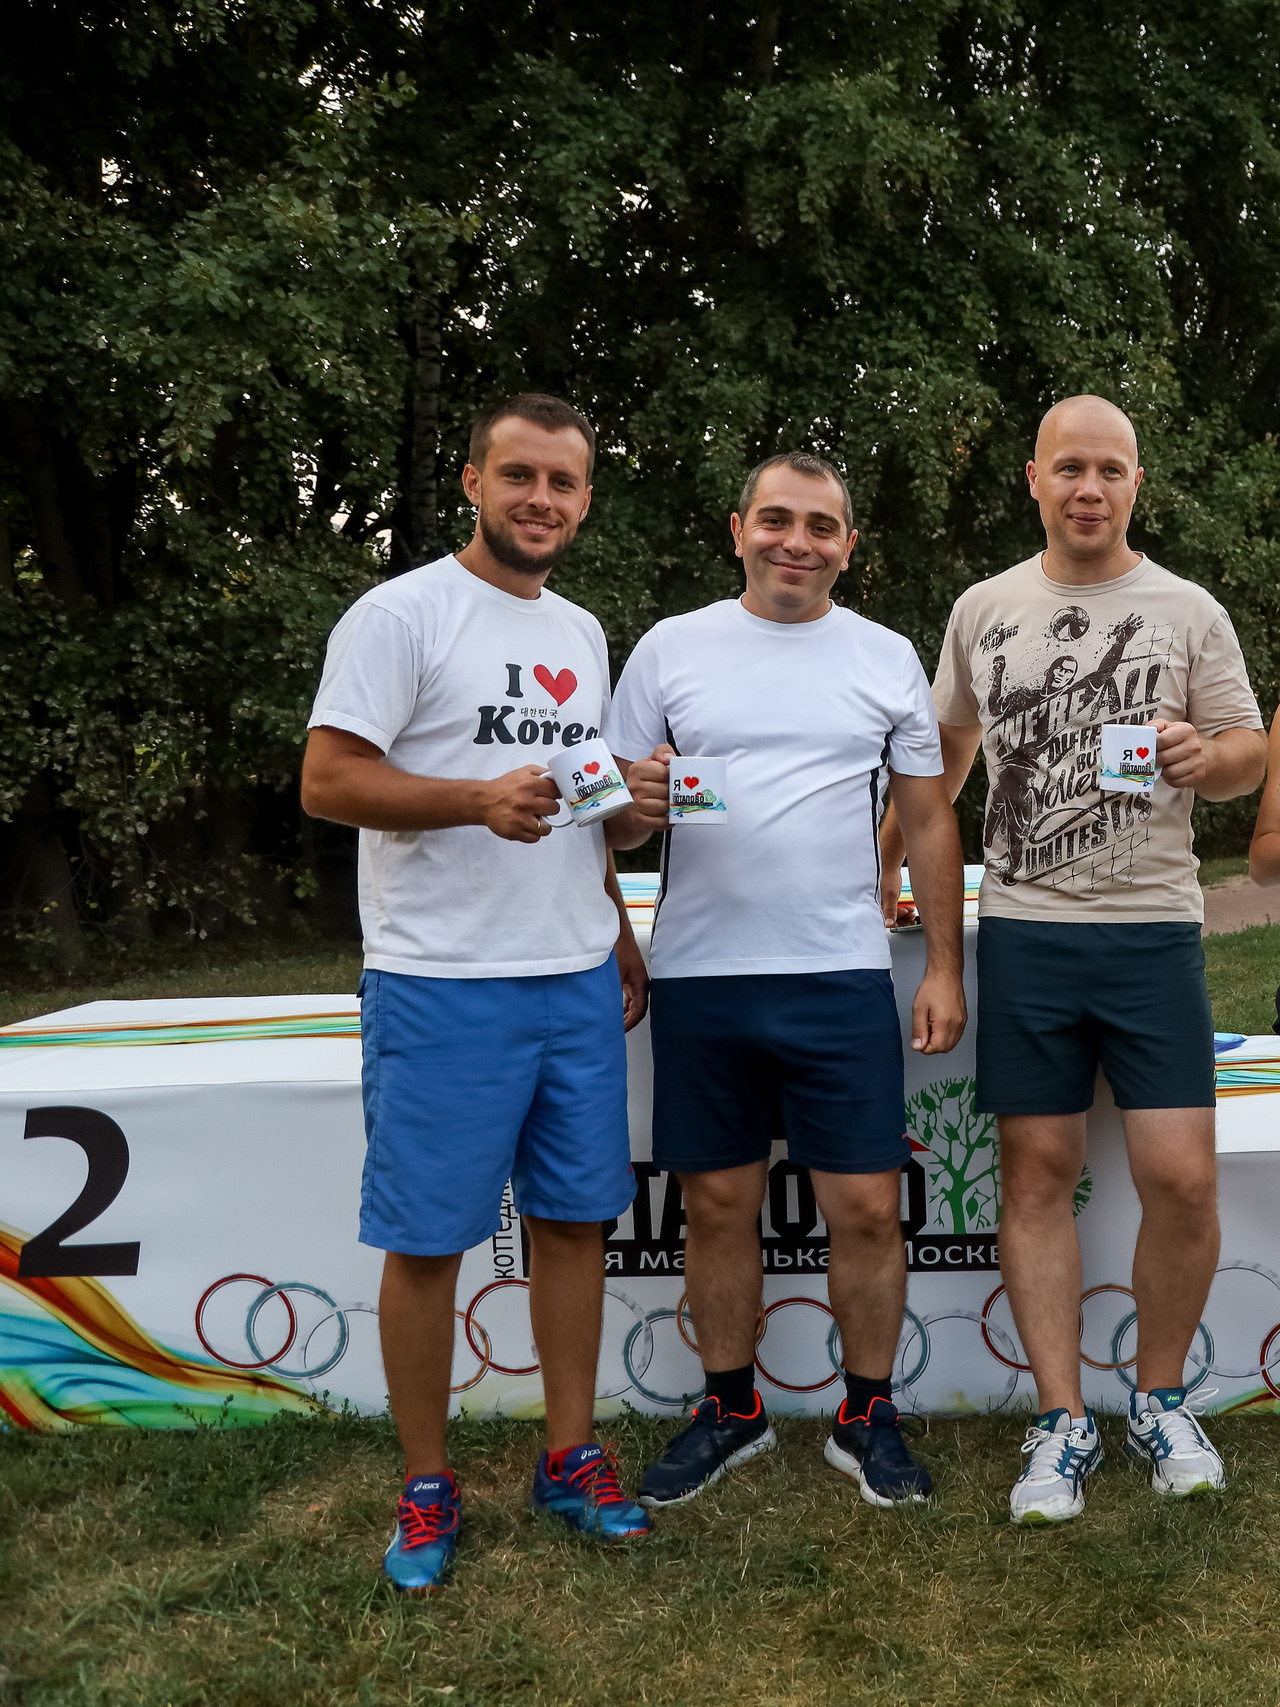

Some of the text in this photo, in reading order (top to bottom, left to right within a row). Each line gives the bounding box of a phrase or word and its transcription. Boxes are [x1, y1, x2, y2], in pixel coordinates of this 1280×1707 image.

[505, 663, 524, 698] I
[1089, 663, 1161, 722] ALL
[521, 707, 558, 719] 대한민국
[1123, 749, 1133, 761] Я
[571, 771, 585, 787] Я
[673, 779, 681, 791] Я
[1025, 820, 1108, 876] UNITES
[18, 1105, 141, 1278] 2
